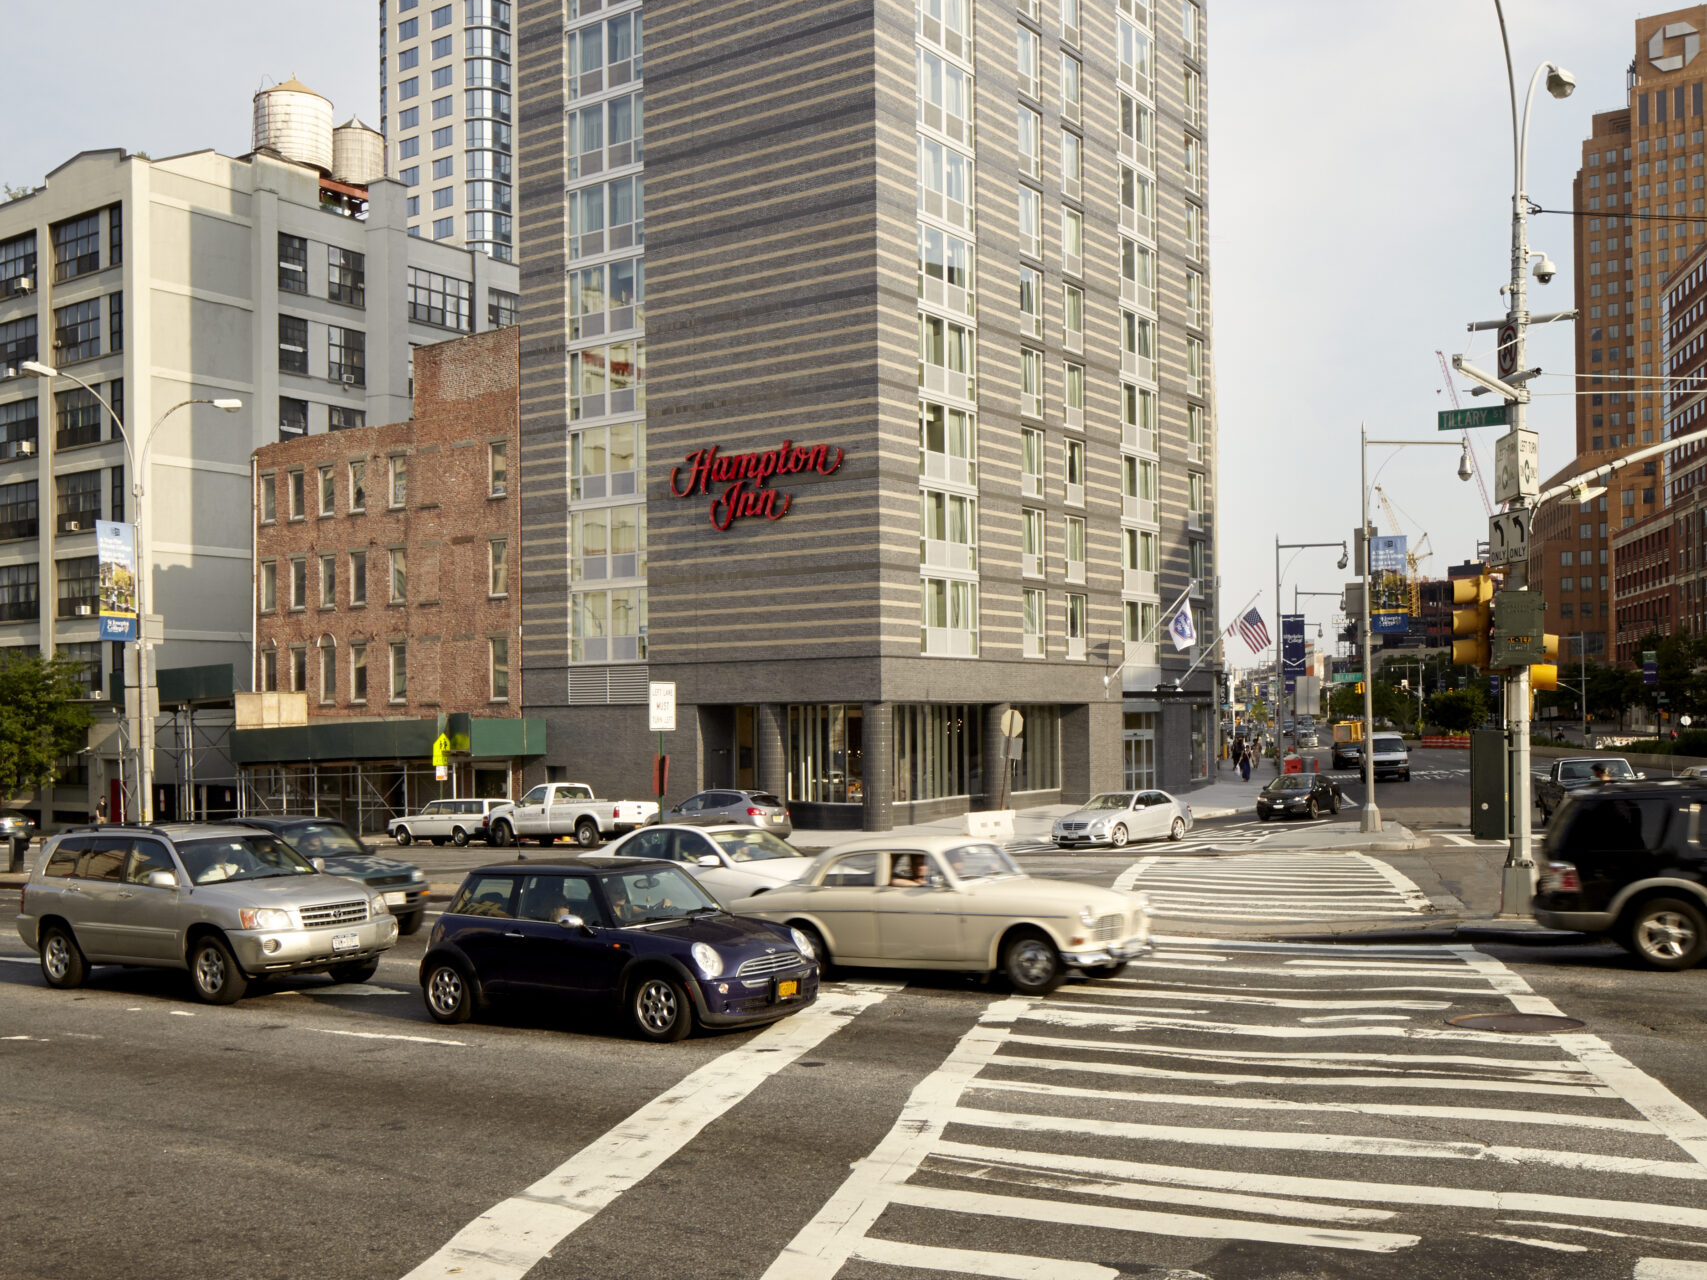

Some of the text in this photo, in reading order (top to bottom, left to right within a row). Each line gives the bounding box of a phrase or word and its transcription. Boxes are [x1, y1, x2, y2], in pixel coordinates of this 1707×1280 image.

[1442, 410, 1488, 427] TILLARY
[670, 439, 844, 498] Hampton
[709, 480, 792, 531] Inn
[1491, 546, 1526, 562] ONLY ONLY
[652, 688, 661, 696] LEFT
[656, 701, 670, 711] MUST
